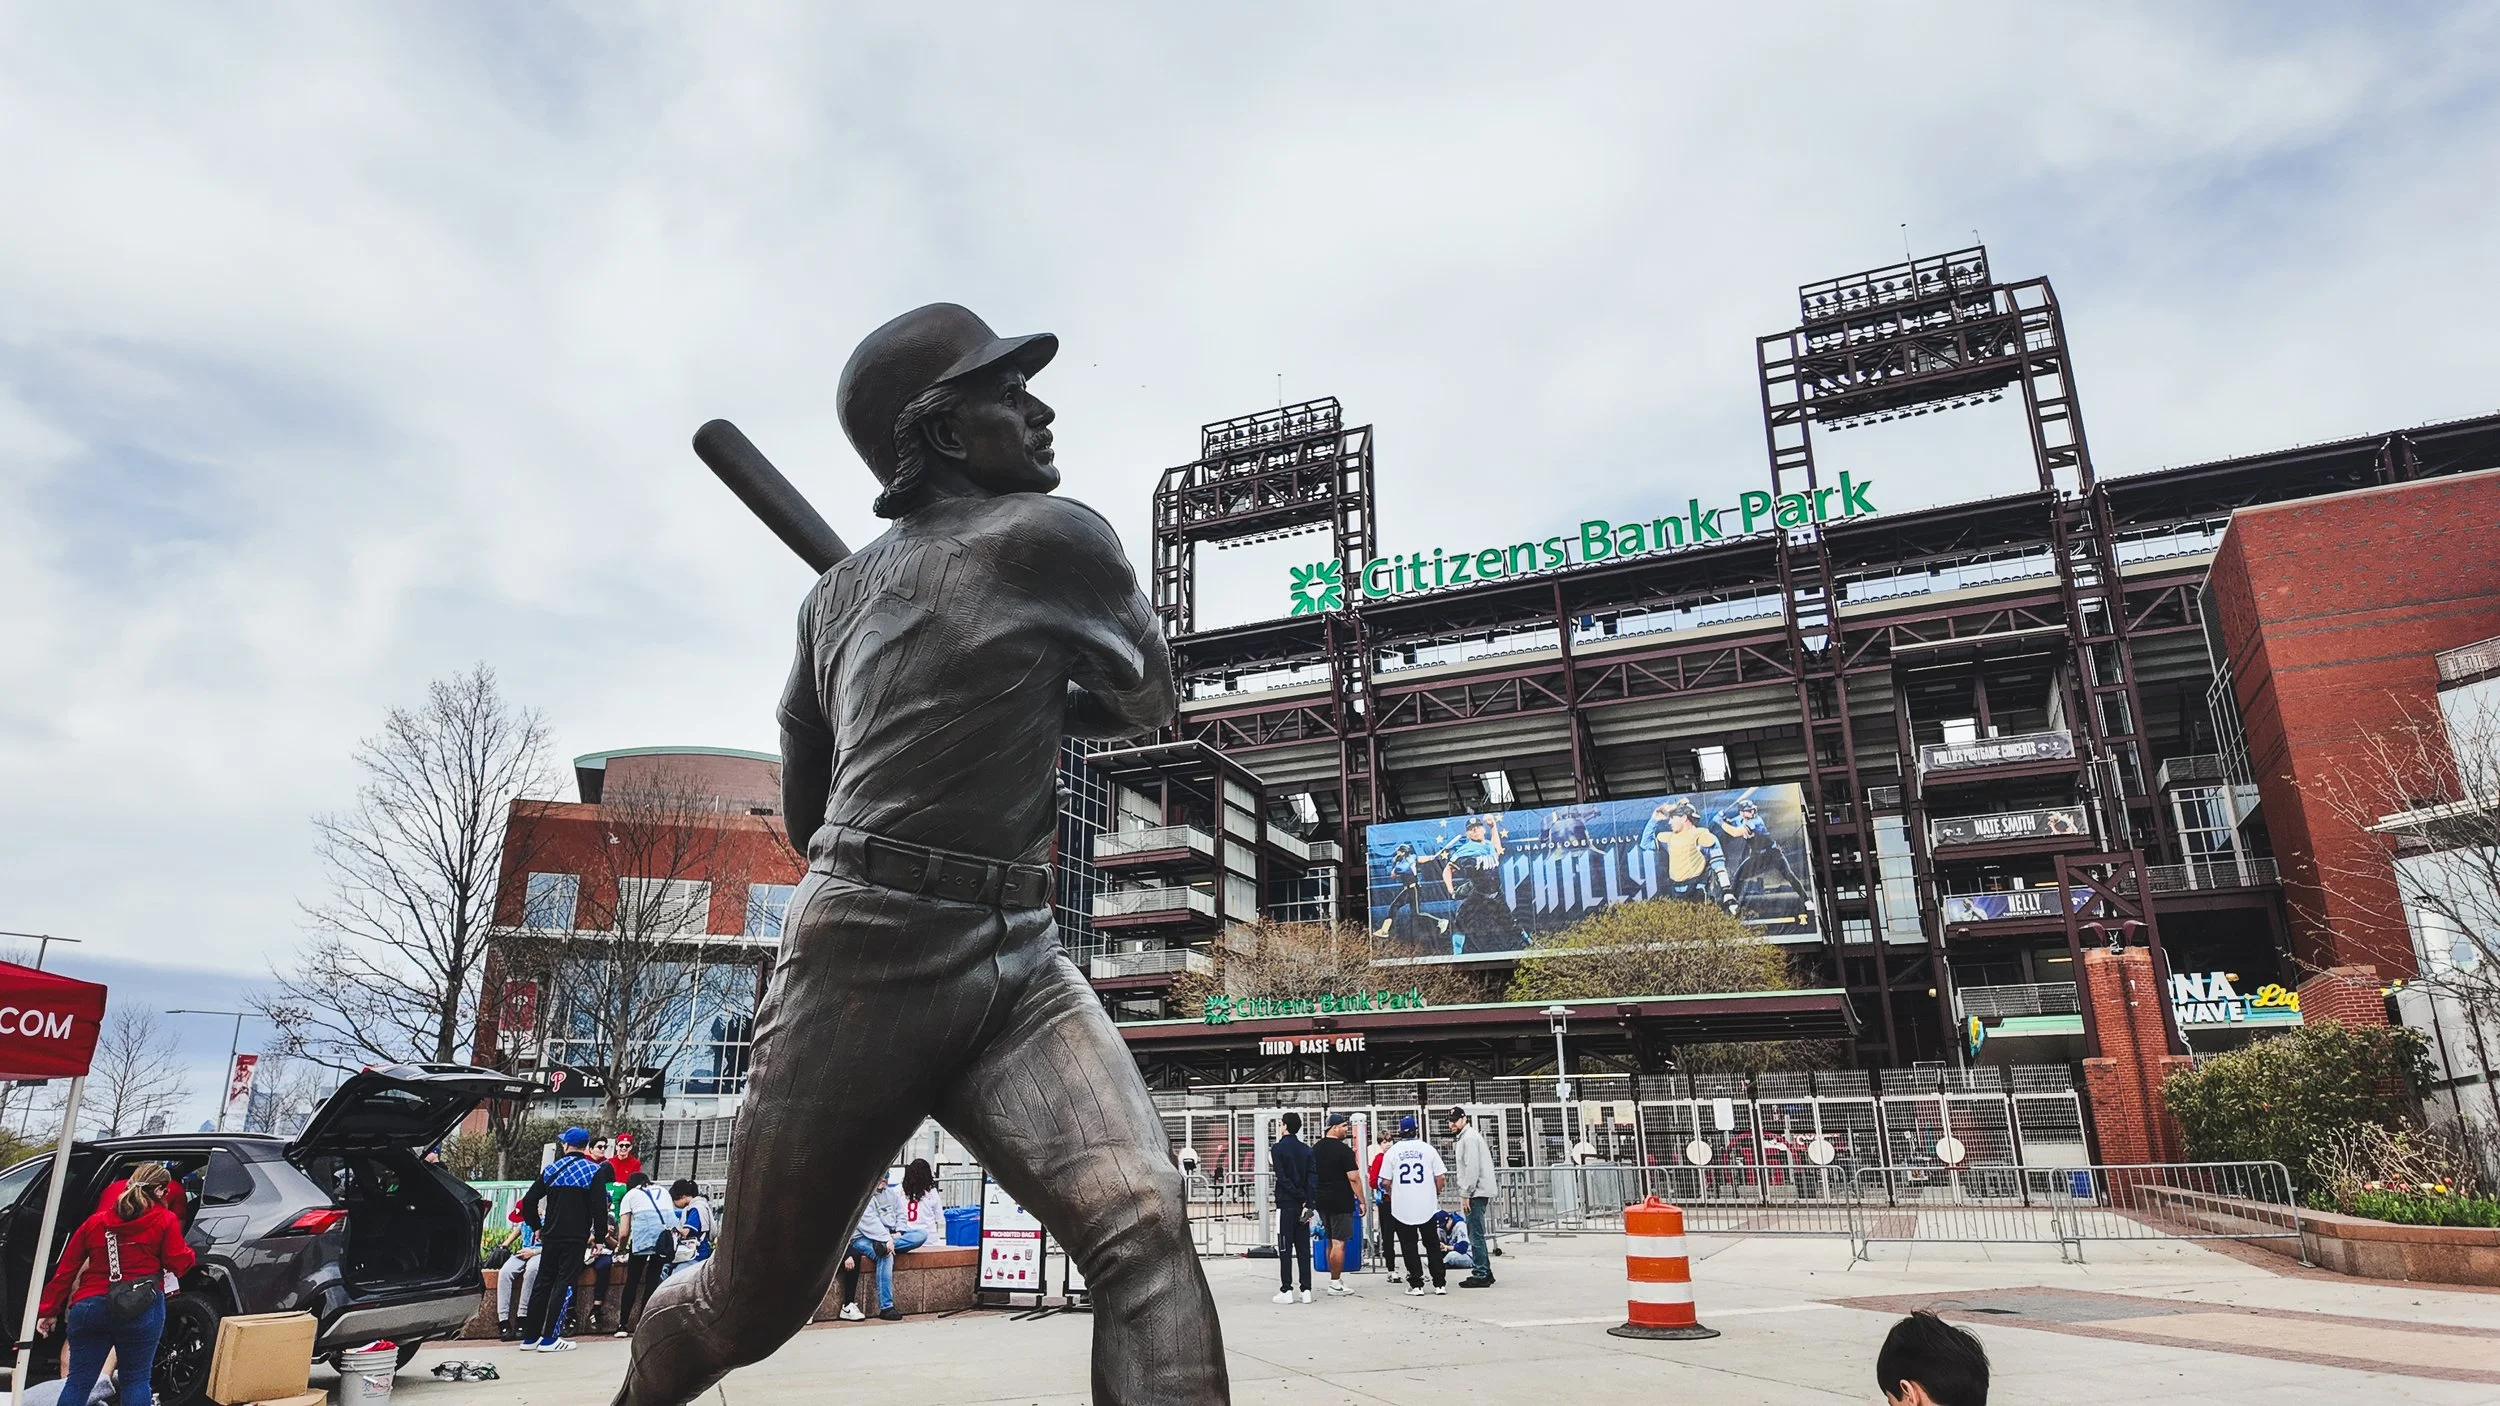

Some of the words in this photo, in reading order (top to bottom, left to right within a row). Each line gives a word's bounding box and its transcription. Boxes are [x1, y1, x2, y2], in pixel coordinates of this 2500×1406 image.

[1360, 536, 1567, 598] Citizens
[1580, 498, 1723, 562] Bank
[1739, 470, 1878, 534] Park
[1933, 749, 1964, 764] PHILLIES
[1964, 745, 2002, 761] POSTGAME
[2002, 741, 2038, 758] CONCERTS
[1973, 819, 2002, 835] NATE
[2002, 815, 2036, 832] SMITH
[1515, 835, 1640, 853] UNAPOLOGETICALLY
[1503, 844, 1659, 915] PHILLY
[2007, 893, 2041, 912] NELLY
[1236, 995, 1316, 1017] Citizens
[1320, 988, 1373, 1013] Bank
[1376, 986, 1425, 1009] Park
[2172, 1002, 2244, 1023] WAVE
[0, 1006, 74, 1040] COM
[1259, 1041, 1293, 1056] THIRD
[1300, 1039, 1330, 1054] BASE
[1335, 1037, 1366, 1052] GATE
[550, 1071, 567, 1093] P
[1398, 1150, 1424, 1161] GIBSON
[1399, 1162, 1424, 1184] 23
[907, 1200, 918, 1222] 8
